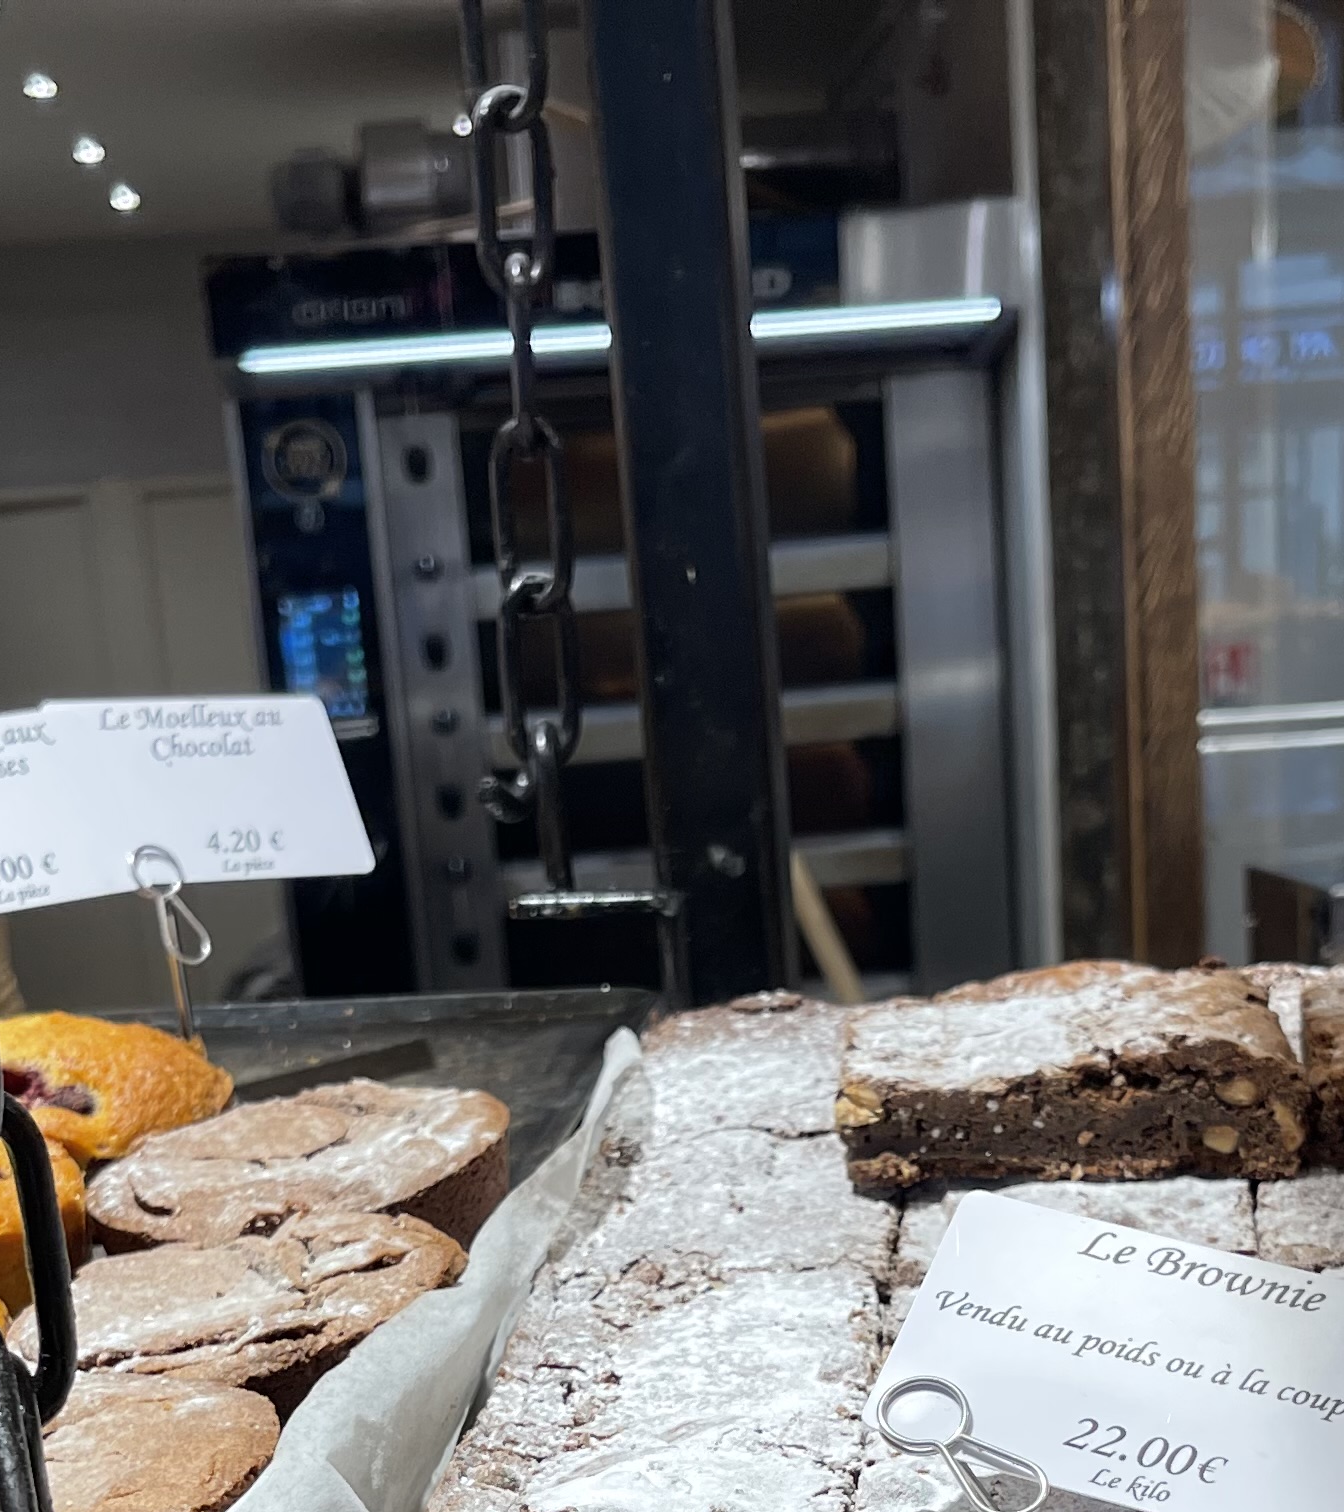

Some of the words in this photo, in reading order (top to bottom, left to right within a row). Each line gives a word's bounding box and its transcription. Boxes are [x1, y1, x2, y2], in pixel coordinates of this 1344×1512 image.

[99, 707, 131, 730] Le
[135, 704, 254, 732] Moelleux
[254, 708, 284, 727] au
[3, 722, 56, 746] aux
[150, 731, 255, 761] Chocolat
[207, 829, 261, 854] 4.20
[269, 830, 285, 851] €
[41, 852, 60, 875] €
[1077, 1231, 1139, 1266] Le
[1146, 1245, 1328, 1313] Brownie
[934, 1289, 1027, 1333] Vendu
[1033, 1320, 1071, 1346] au
[1072, 1331, 1161, 1368] poids
[1166, 1355, 1202, 1380] ou
[1211, 1363, 1231, 1386] à
[1239, 1366, 1269, 1396] la
[1063, 1416, 1229, 1485] 22.00€
[1089, 1469, 1122, 1490] Le
[1126, 1476, 1171, 1504] kilo
